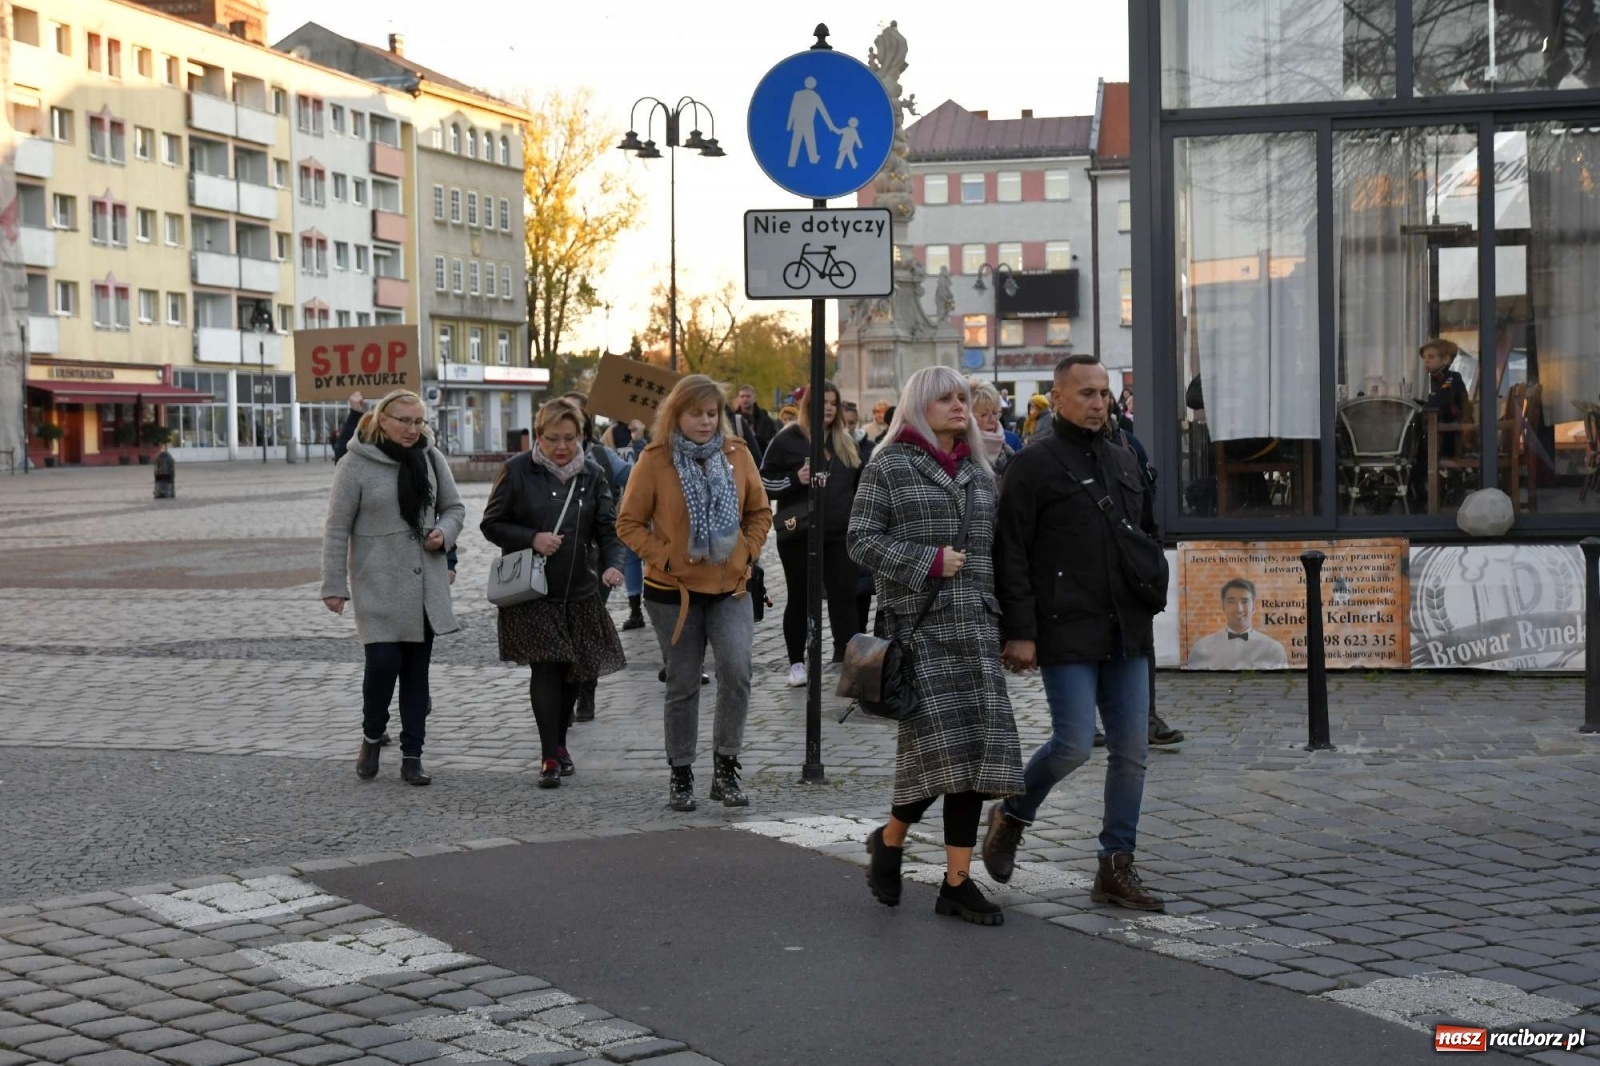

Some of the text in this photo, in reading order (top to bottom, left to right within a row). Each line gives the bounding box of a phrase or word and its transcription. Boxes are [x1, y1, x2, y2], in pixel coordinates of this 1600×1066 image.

[754, 215, 886, 238] Nie dotyczy
[311, 340, 407, 377] STOP
[1190, 555, 1217, 564] Jesteś
[1350, 551, 1395, 562] pracowity
[1269, 566, 1304, 576] otwarty
[1321, 565, 1344, 573] nowe
[1346, 563, 1396, 574] wyzwania?
[1345, 575, 1354, 583] to
[1356, 574, 1395, 585] szukamy
[1328, 599, 1340, 607] na
[1342, 598, 1396, 607] stanowisko
[1264, 611, 1395, 626] Kelne Kelnerka
[1324, 634, 1340, 647] 98
[1343, 634, 1368, 647] 623
[1372, 634, 1397, 646] 315
[1428, 615, 1587, 667] Browar Rynek
